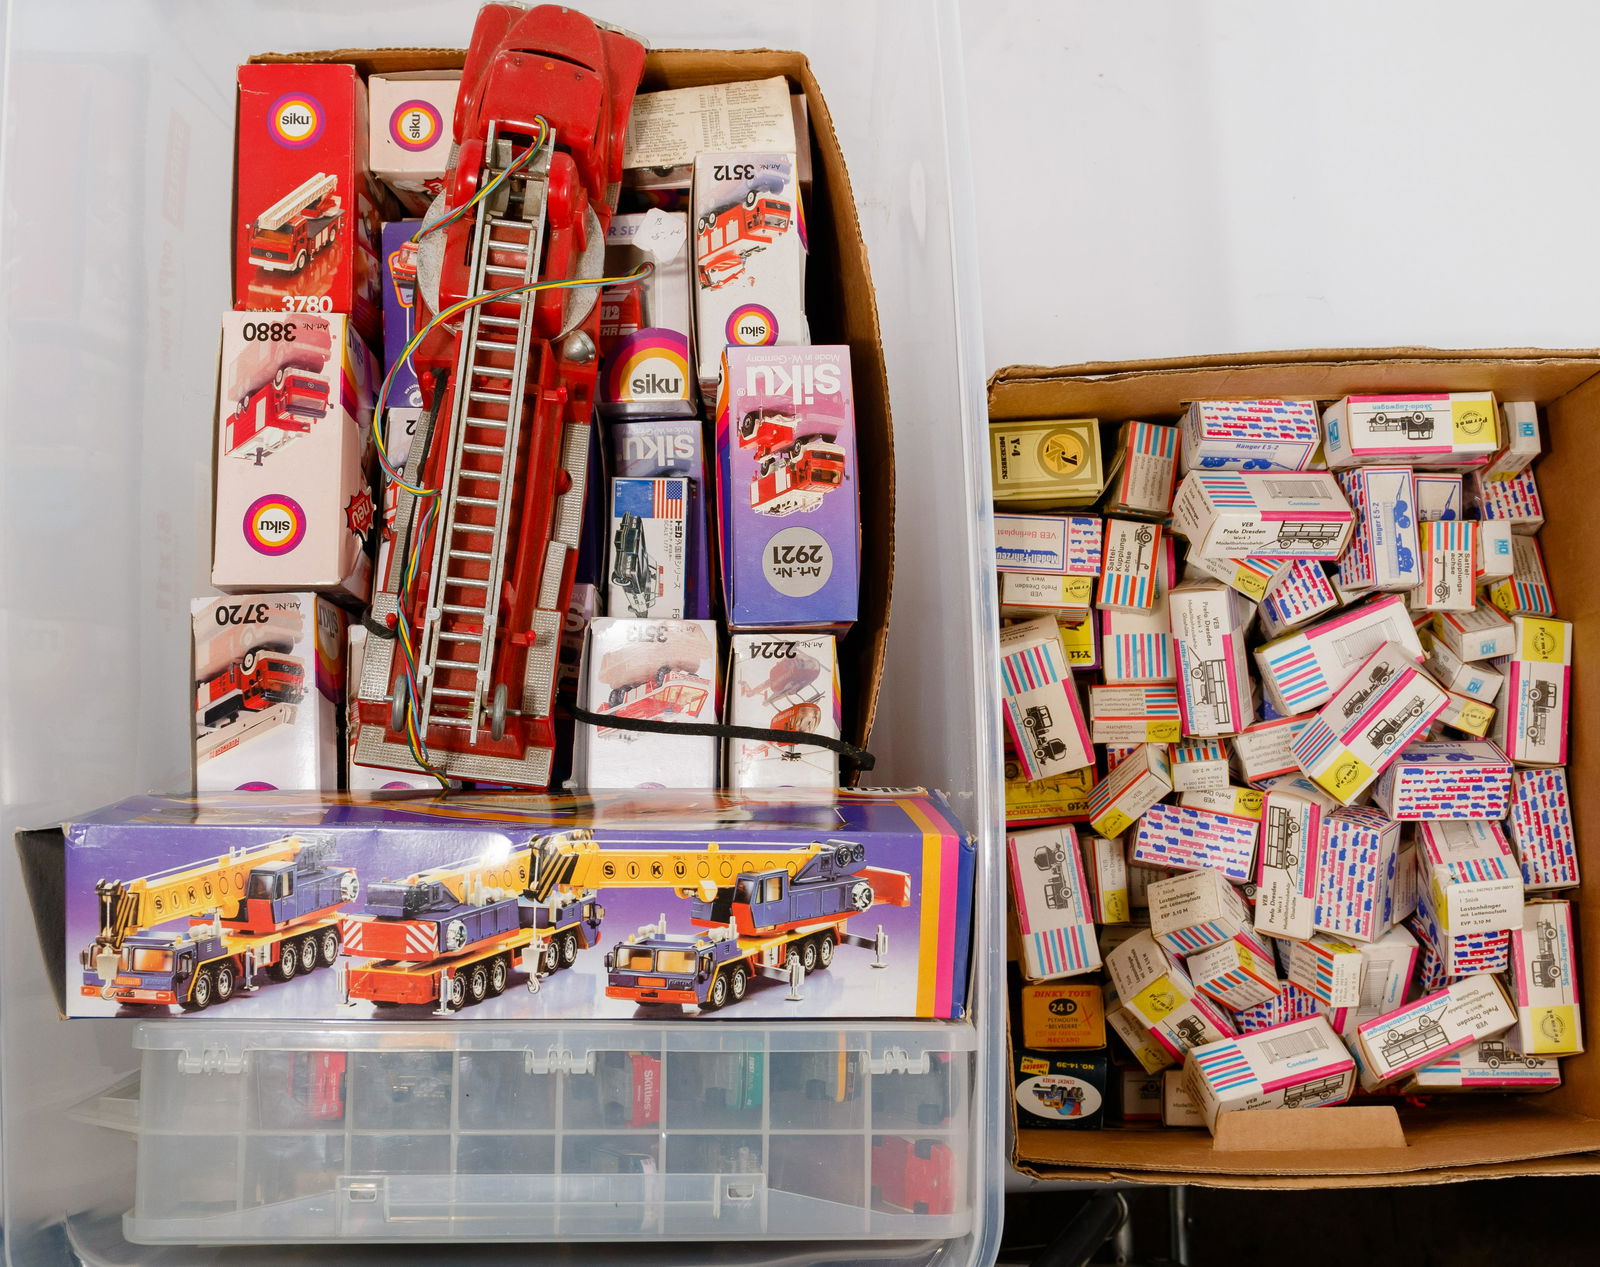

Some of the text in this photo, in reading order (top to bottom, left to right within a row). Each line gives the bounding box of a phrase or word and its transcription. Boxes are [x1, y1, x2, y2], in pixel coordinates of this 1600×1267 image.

[282, 112, 311, 125] siku
[411, 113, 421, 138] siku
[714, 165, 755, 181] 3512
[282, 296, 333, 313] 3780
[243, 323, 297, 341] 3880
[740, 326, 766, 336] siku
[803, 354, 812, 362] in
[815, 354, 841, 363] Made
[632, 375, 682, 394] siku
[1372, 403, 1433, 411] Skoda-Zugwagen
[622, 434, 695, 467] siku
[1011, 438, 1021, 456] Y-4
[352, 503, 369, 525] neu
[259, 520, 290, 533] siku
[998, 530, 1037, 538] Berlinplast
[773, 545, 823, 565] 2921
[1115, 531, 1126, 572] Kupplungs-
[1124, 551, 1132, 572] achse
[216, 604, 269, 625] 3720
[1204, 620, 1212, 647] Dresden
[749, 640, 797, 659] 2224
[1518, 679, 1529, 739] Skoda-Zugwagen
[1384, 711, 1431, 757] Skoda-Zugwagen
[604, 866, 685, 875] SIKU
[155, 881, 212, 913] SIKU
[1460, 904, 1501, 912] Lastanhänger
[1561, 924, 1570, 986] Skoda-Zugwagen
[1387, 973, 1398, 1004] Container
[1051, 1003, 1064, 1012] 24
[1455, 1006, 1499, 1027] Prefo Dresden
[1476, 1021, 1489, 1030] VEB
[645, 1070, 654, 1109] Skittles
